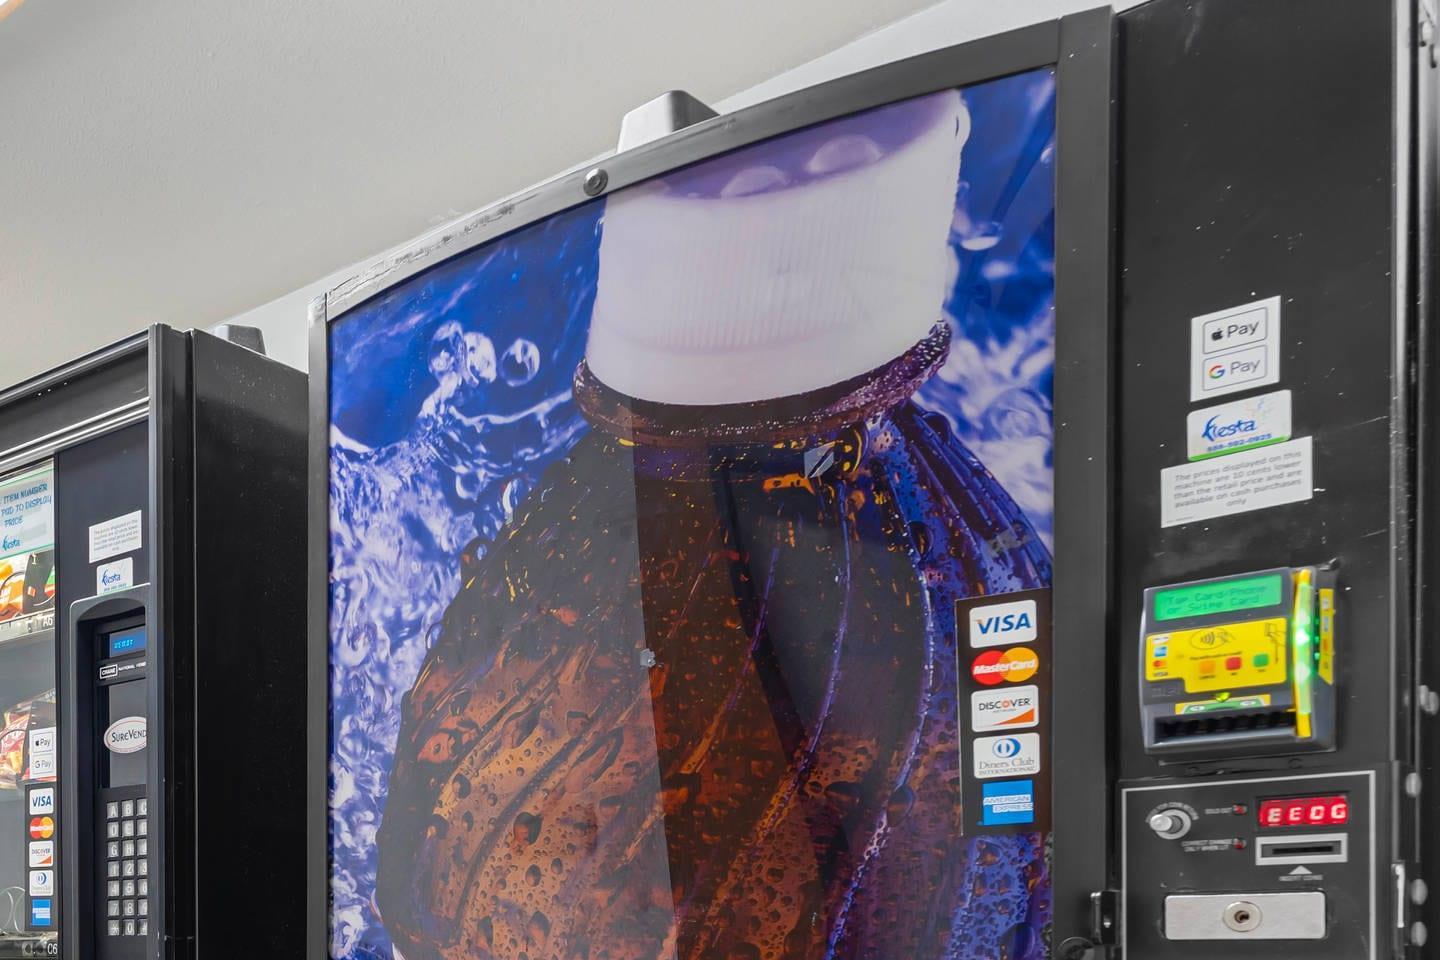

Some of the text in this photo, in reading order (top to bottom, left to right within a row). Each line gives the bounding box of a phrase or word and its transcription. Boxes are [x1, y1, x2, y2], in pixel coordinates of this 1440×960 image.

[1227, 320, 1259, 338] Pay
[1230, 359, 1261, 375] Pay
[20, 483, 48, 499] NUMBER
[977, 613, 1031, 634] VISA
[972, 659, 1036, 676] MasterCard
[978, 698, 1031, 711] DISCOVER
[40, 738, 50, 747] Pay
[1011, 757, 1035, 767] Club
[32, 795, 52, 807] VISA
[47, 944, 57, 955] C6
